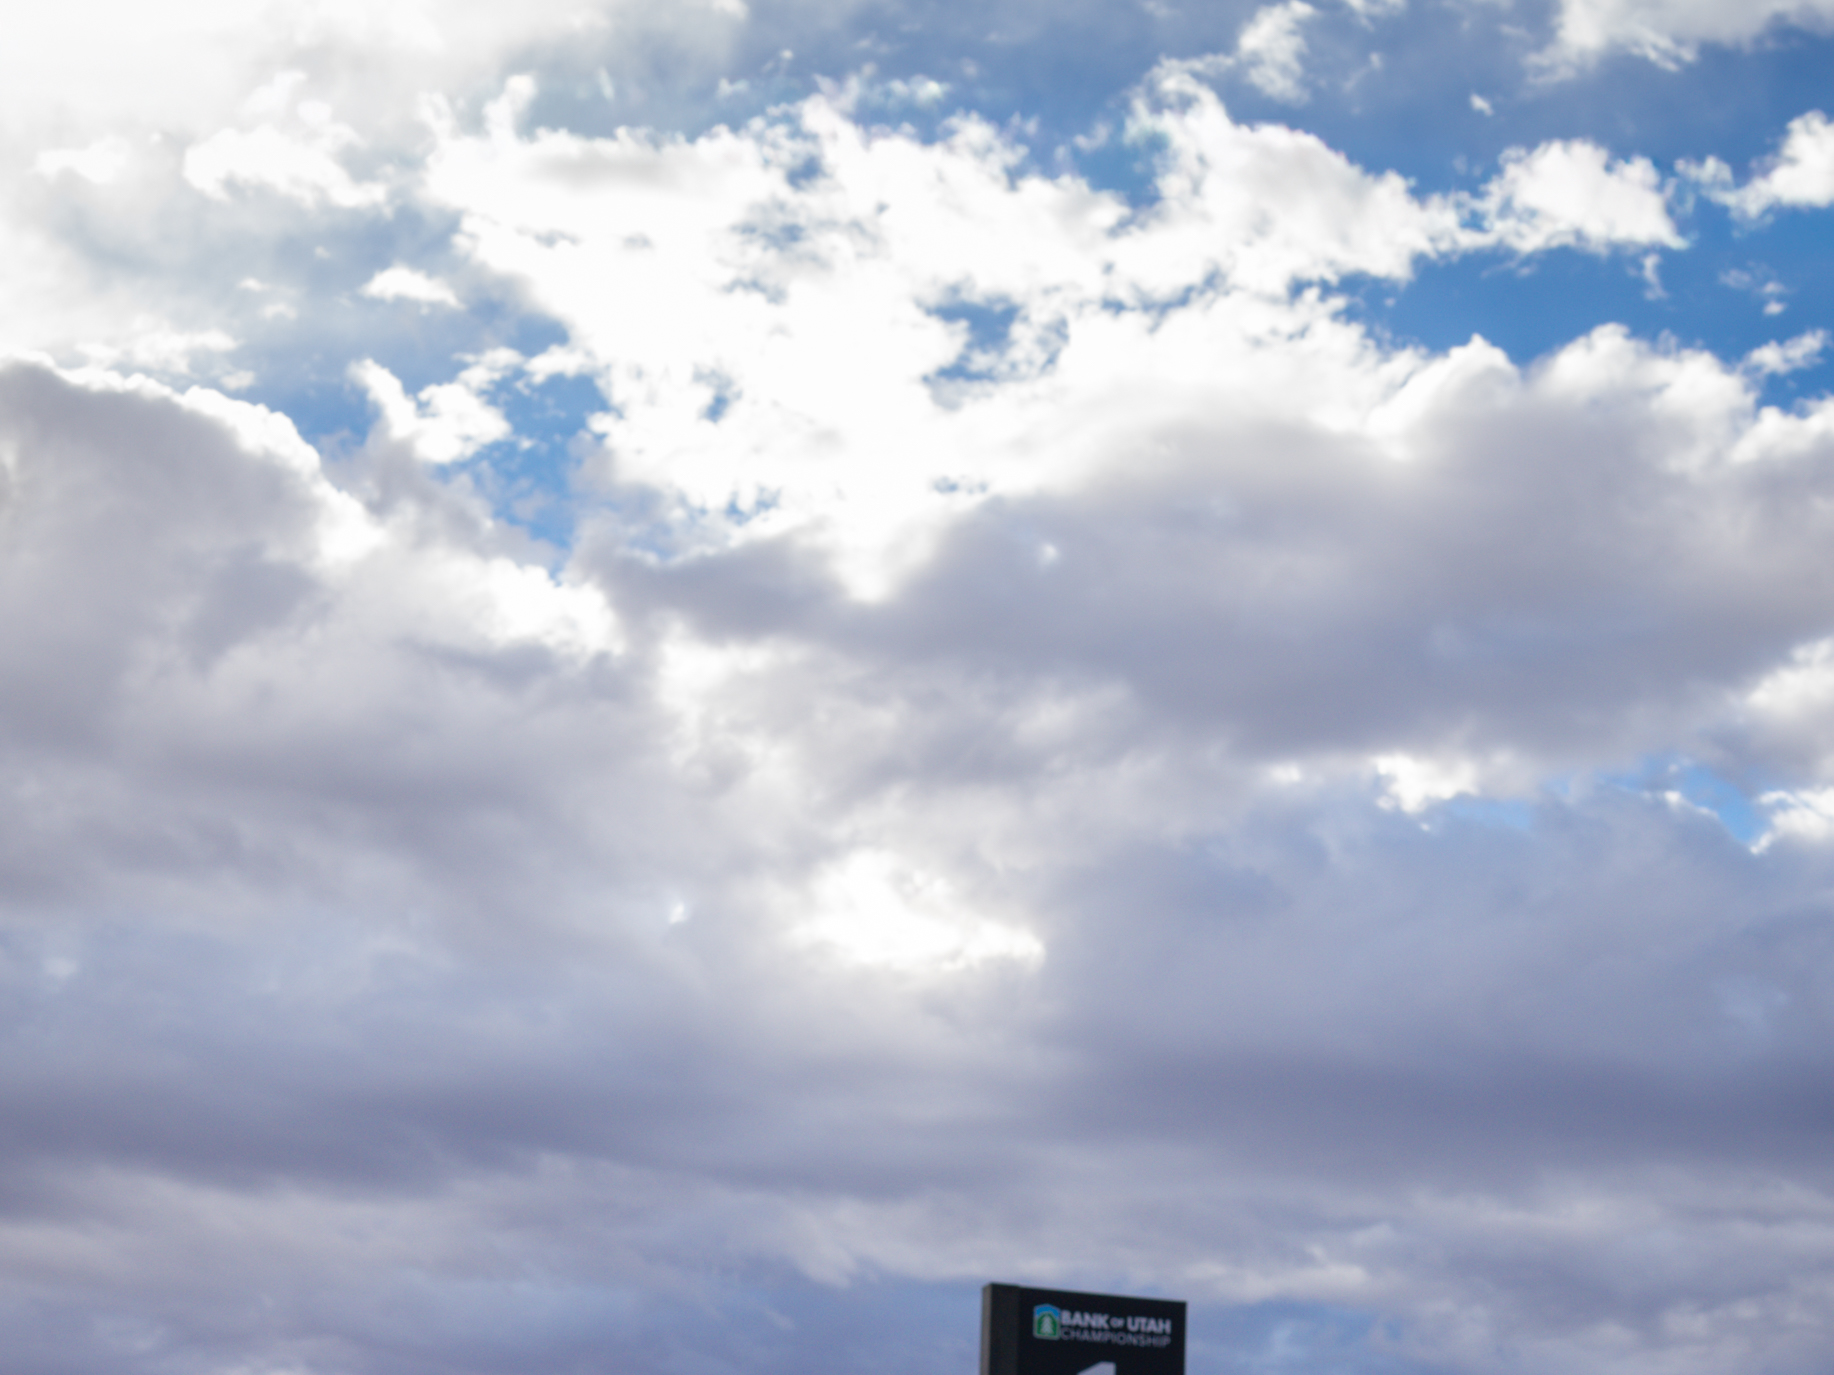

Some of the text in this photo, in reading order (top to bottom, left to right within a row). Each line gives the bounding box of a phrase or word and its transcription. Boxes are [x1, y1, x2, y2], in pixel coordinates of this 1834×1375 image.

[1061, 1310, 1172, 1334] BANK OF UTAH
[1061, 1327, 1172, 1348] CHAMPIONSHIP
